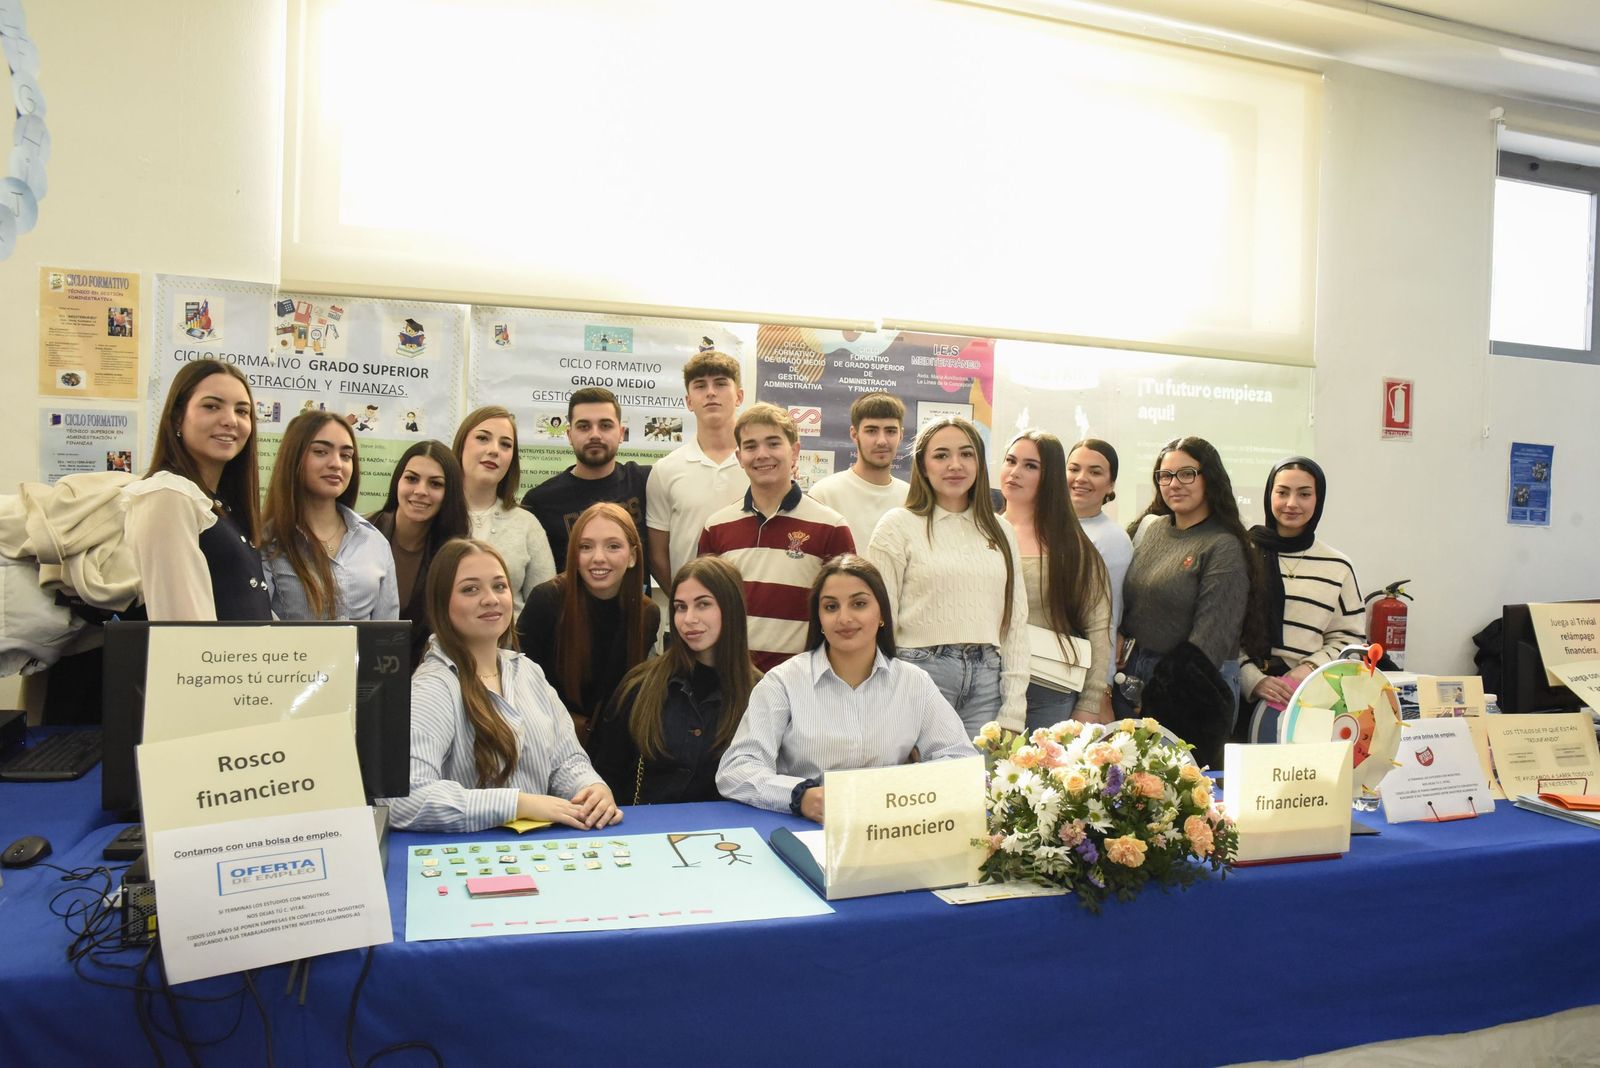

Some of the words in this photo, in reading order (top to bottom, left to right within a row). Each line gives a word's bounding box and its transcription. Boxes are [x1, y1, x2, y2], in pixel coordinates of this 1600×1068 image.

[89, 276, 129, 290] FORMATIVO
[774, 349, 815, 358] FORMATIVO
[804, 358, 826, 366] MEDIO
[850, 353, 889, 362] FORMATIVO
[220, 352, 300, 369] FORMAIVO
[309, 359, 359, 374] GRADO
[363, 364, 429, 378] SUPERIOR
[559, 358, 592, 369] CICLO
[595, 360, 662, 373] FORMATIVO
[246, 374, 317, 389] ISTRACIÓN
[325, 379, 332, 390] Y
[340, 380, 408, 396] FINANZAS.
[571, 375, 613, 387] GRADO
[617, 378, 655, 389] MEDIO
[764, 381, 822, 390] ADMINISTRATIVA
[839, 377, 897, 387] ADMINISTRACIÓN
[532, 390, 572, 401] GESTIÓ
[615, 394, 685, 407] INISTRATIVA
[1165, 378, 1211, 397] futuro
[1213, 384, 1273, 404] empieza
[65, 414, 86, 426] CICLO
[87, 414, 127, 427] FORMATIVO
[1577, 618, 1596, 626] Trivial
[1561, 633, 1595, 641] relámpago
[201, 650, 258, 664] Quieres
[262, 652, 288, 665] que
[294, 651, 307, 662] te
[177, 672, 243, 687] hagamos
[248, 672, 262, 684] tú
[267, 670, 329, 683] currículo
[233, 693, 273, 706] vitae.
[218, 750, 286, 772] Rosco
[1272, 765, 1317, 782] Ruleta
[196, 776, 315, 809] financiero
[885, 788, 937, 808] Rosco
[1256, 793, 1328, 811] financiera.
[866, 817, 955, 841] financiero
[174, 845, 223, 859] Contamos
[225, 842, 243, 851] con
[245, 840, 263, 848] una
[265, 837, 290, 846] bolsa
[293, 834, 303, 842] de
[306, 830, 342, 841] empleo.
[230, 859, 315, 878] OFERTA
[232, 876, 255, 885] DE
[256, 867, 316, 881] EMPLEO
[225, 905, 252, 914] TERMINAS
[264, 899, 288, 907] ESTUDIOS
[217, 927, 232, 935] AÑOS
[240, 922, 259, 930] PONEN
[260, 917, 288, 927] EMPRESAS
[297, 911, 324, 920] CONTACTO
[338, 904, 365, 913] NOSOTROS
[194, 937, 223, 947] BUSCANDO
[241, 926, 281, 938] TRABAJADORES
[282, 923, 298, 931] ENTRE
[299, 918, 326, 928] NUESTROS
[327, 912, 360, 922] ALUMNOS-AS
